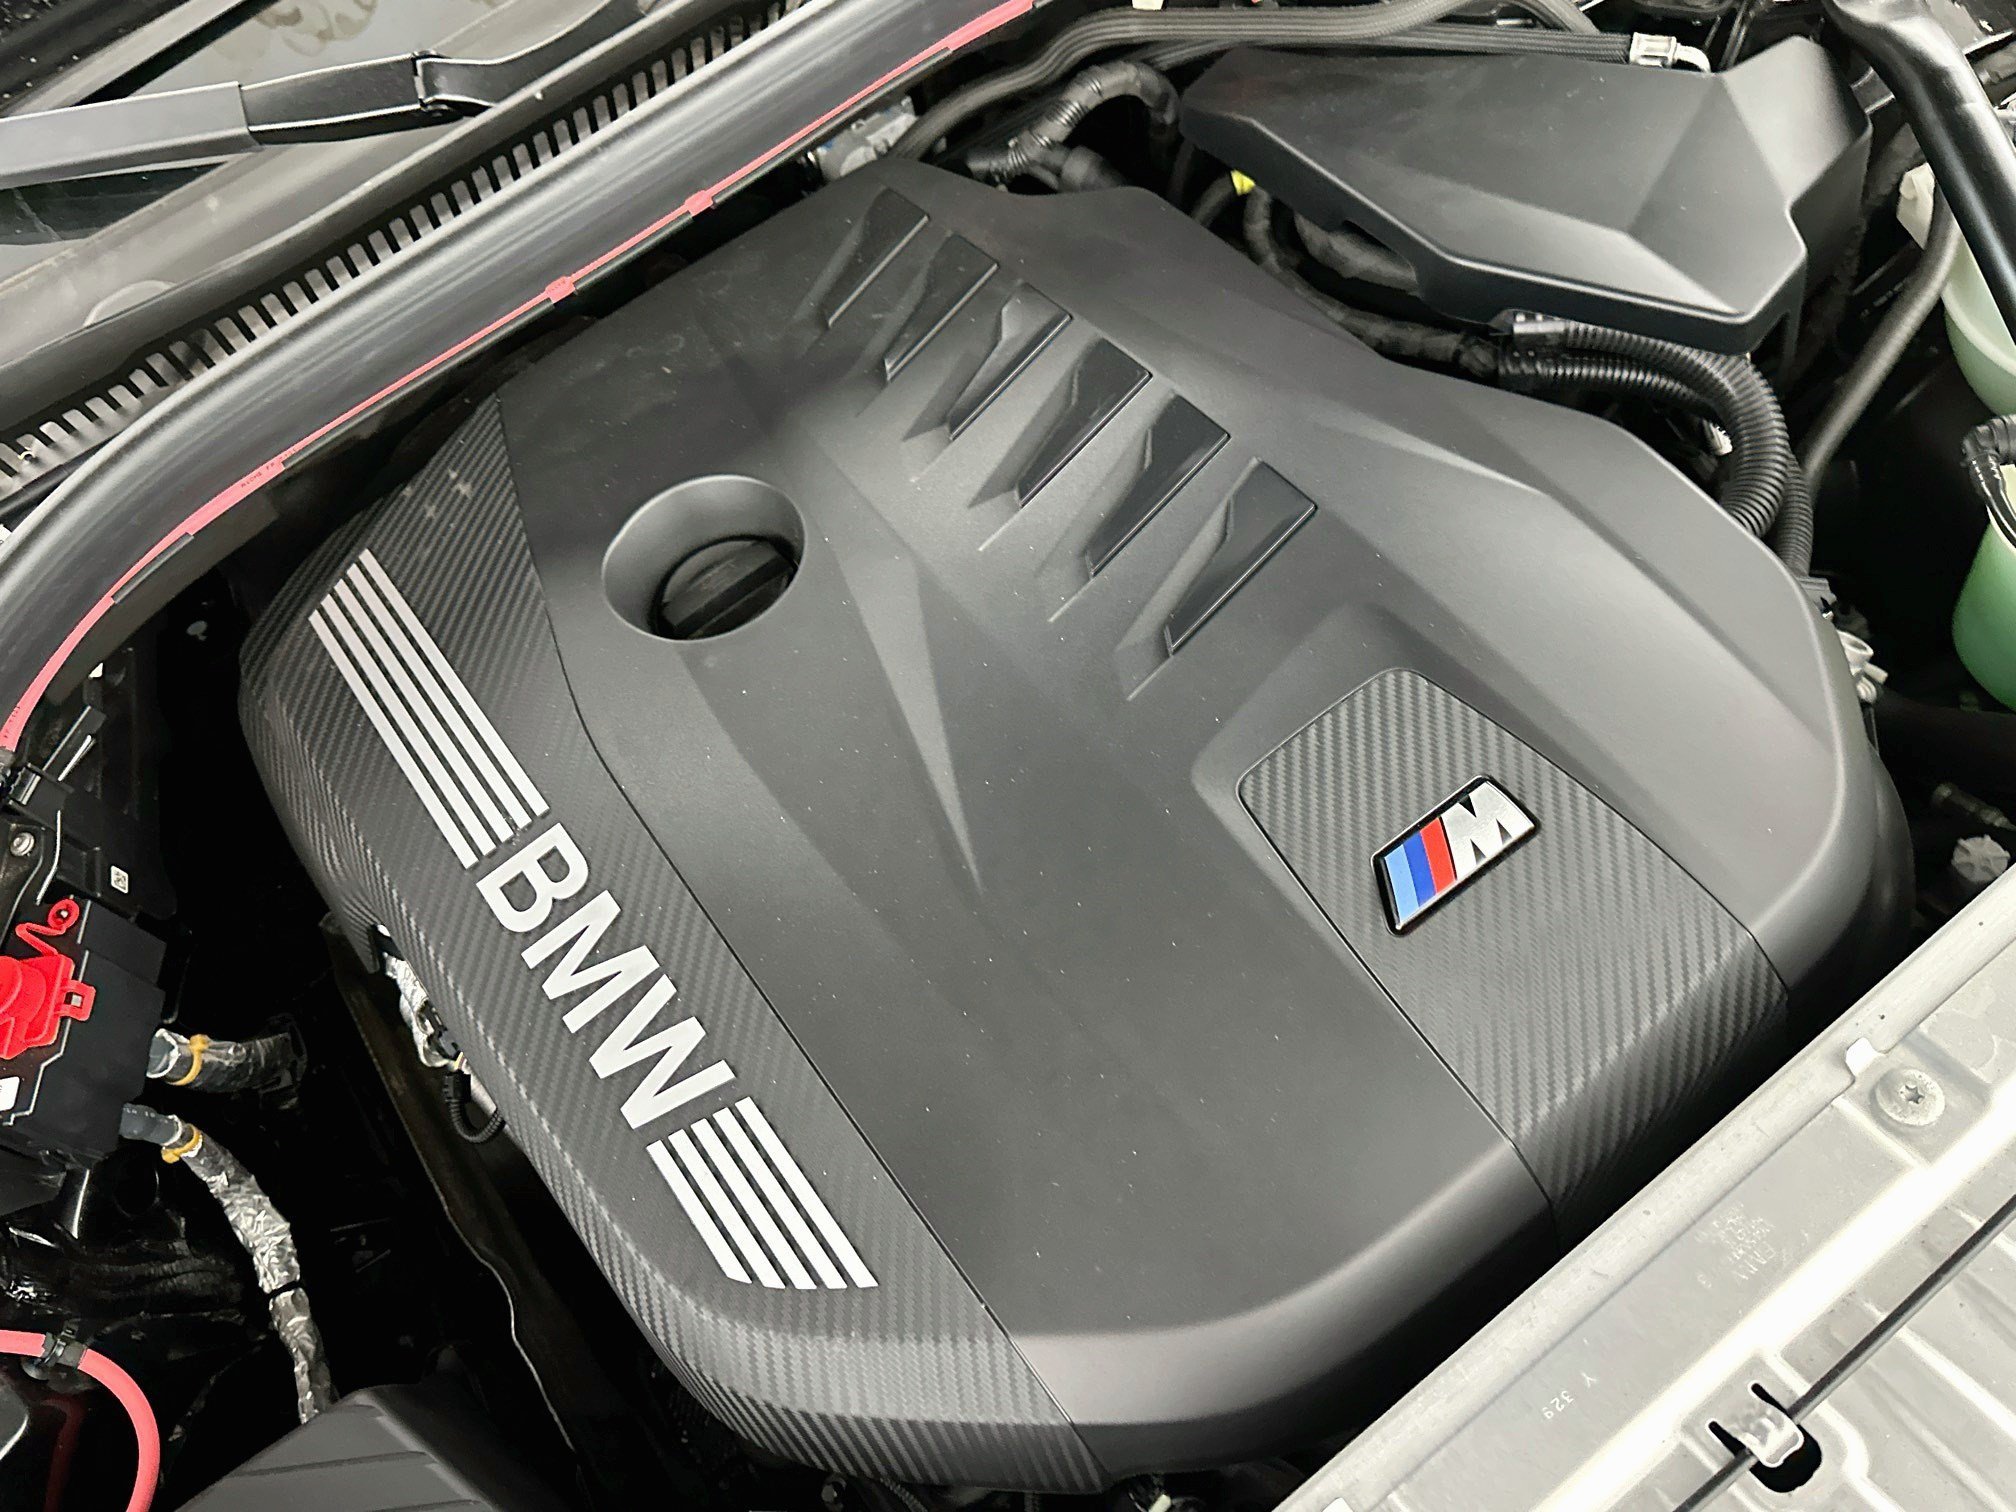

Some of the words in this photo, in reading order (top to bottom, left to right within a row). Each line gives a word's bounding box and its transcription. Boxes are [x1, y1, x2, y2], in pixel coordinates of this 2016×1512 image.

[1441, 780, 1535, 881] M
[476, 822, 736, 1130] BMW
[1542, 1390, 1574, 1419] 329
